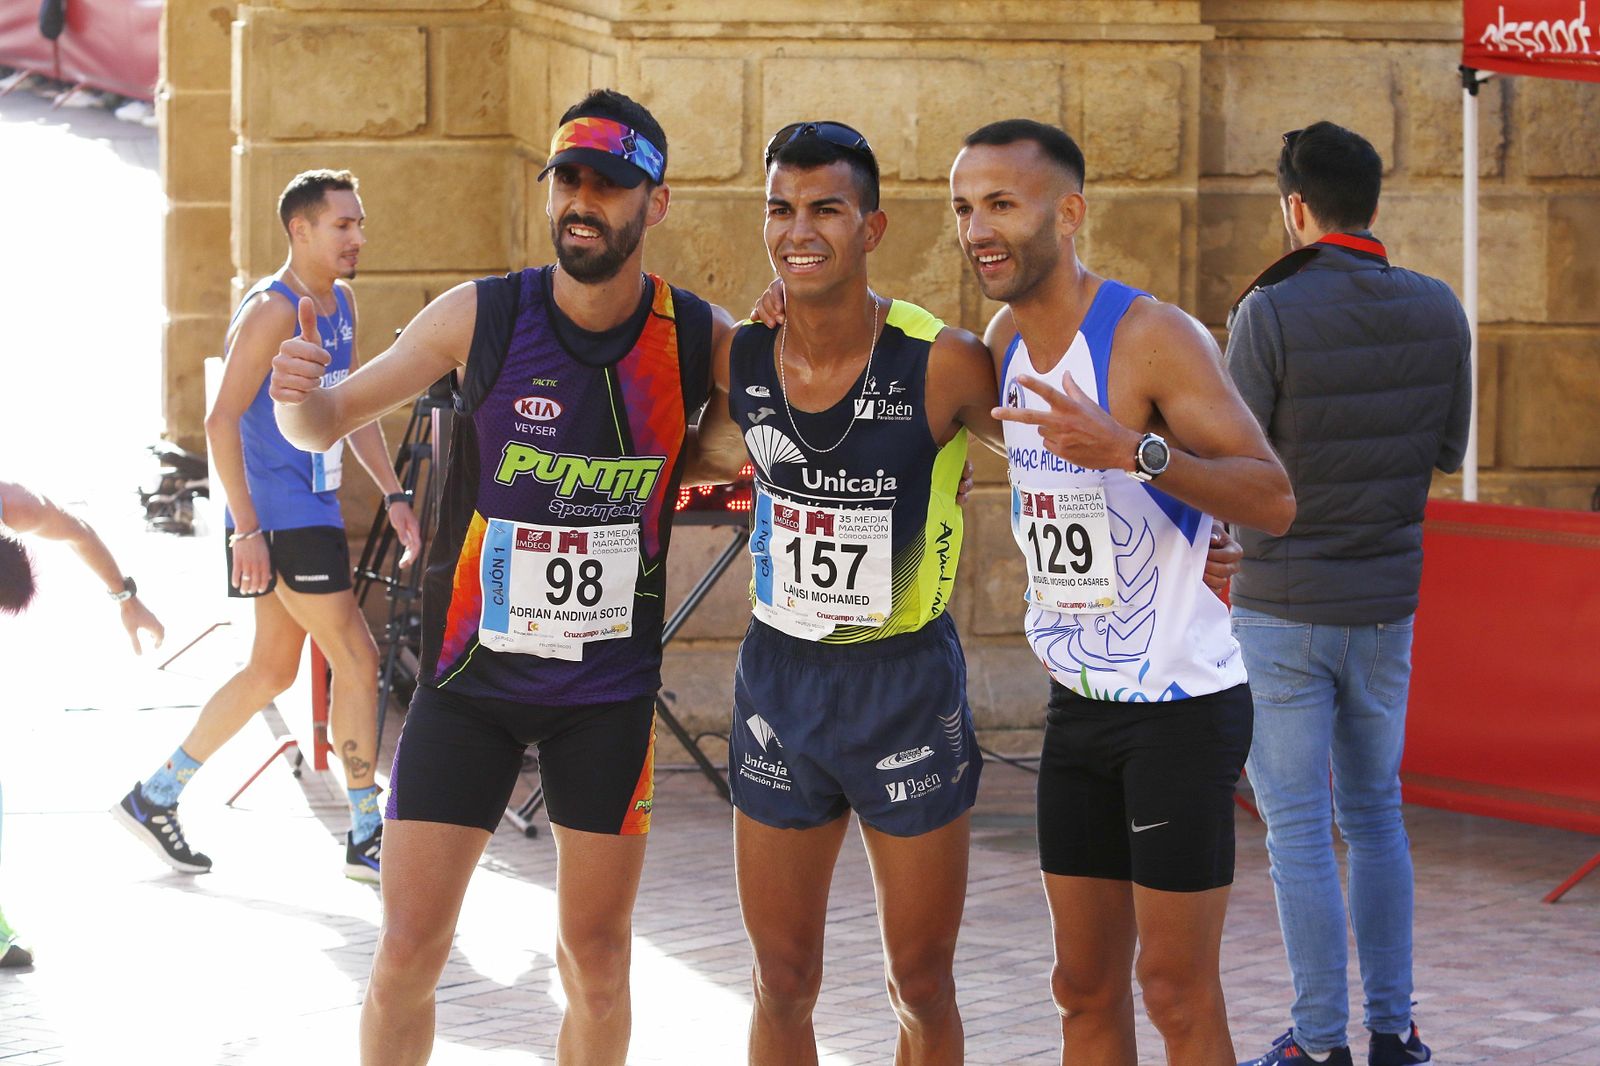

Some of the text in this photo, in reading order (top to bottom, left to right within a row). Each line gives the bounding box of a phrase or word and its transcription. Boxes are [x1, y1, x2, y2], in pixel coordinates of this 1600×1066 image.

[532, 378, 558, 387] TACTIC
[520, 400, 555, 418] KIA
[877, 399, 913, 416] Jaén
[514, 421, 557, 437] VEYSER
[802, 467, 897, 497] Unicaja
[1058, 493, 1103, 502] 35 MEDIA
[1058, 502, 1104, 512] MARATÓN
[838, 515, 888, 523] 35 MEDIA
[593, 529, 637, 539] 35 MEDIA
[838, 523, 889, 532] MARATÓN
[516, 540, 551, 550] IMDECO
[592, 538, 638, 548] MARATÓN
[1028, 521, 1093, 575] 129
[786, 536, 868, 591] 157
[492, 558, 504, 606] CAJÓN
[546, 557, 603, 607] 98
[1050, 576, 1076, 587] MORENO
[1077, 577, 1110, 587] CASARES
[783, 582, 870, 606] LANSI MOHAMED
[509, 605, 627, 621] ADRIAN ANDIVIA SOTO
[1056, 600, 1087, 610] Cruzcampo
[816, 611, 855, 622] Cruzcampo
[563, 629, 599, 639] Cruzcampo
[744, 752, 788, 777] Unicaja
[739, 767, 791, 792] Fundación Jaén
[906, 773, 942, 795] Jaén
